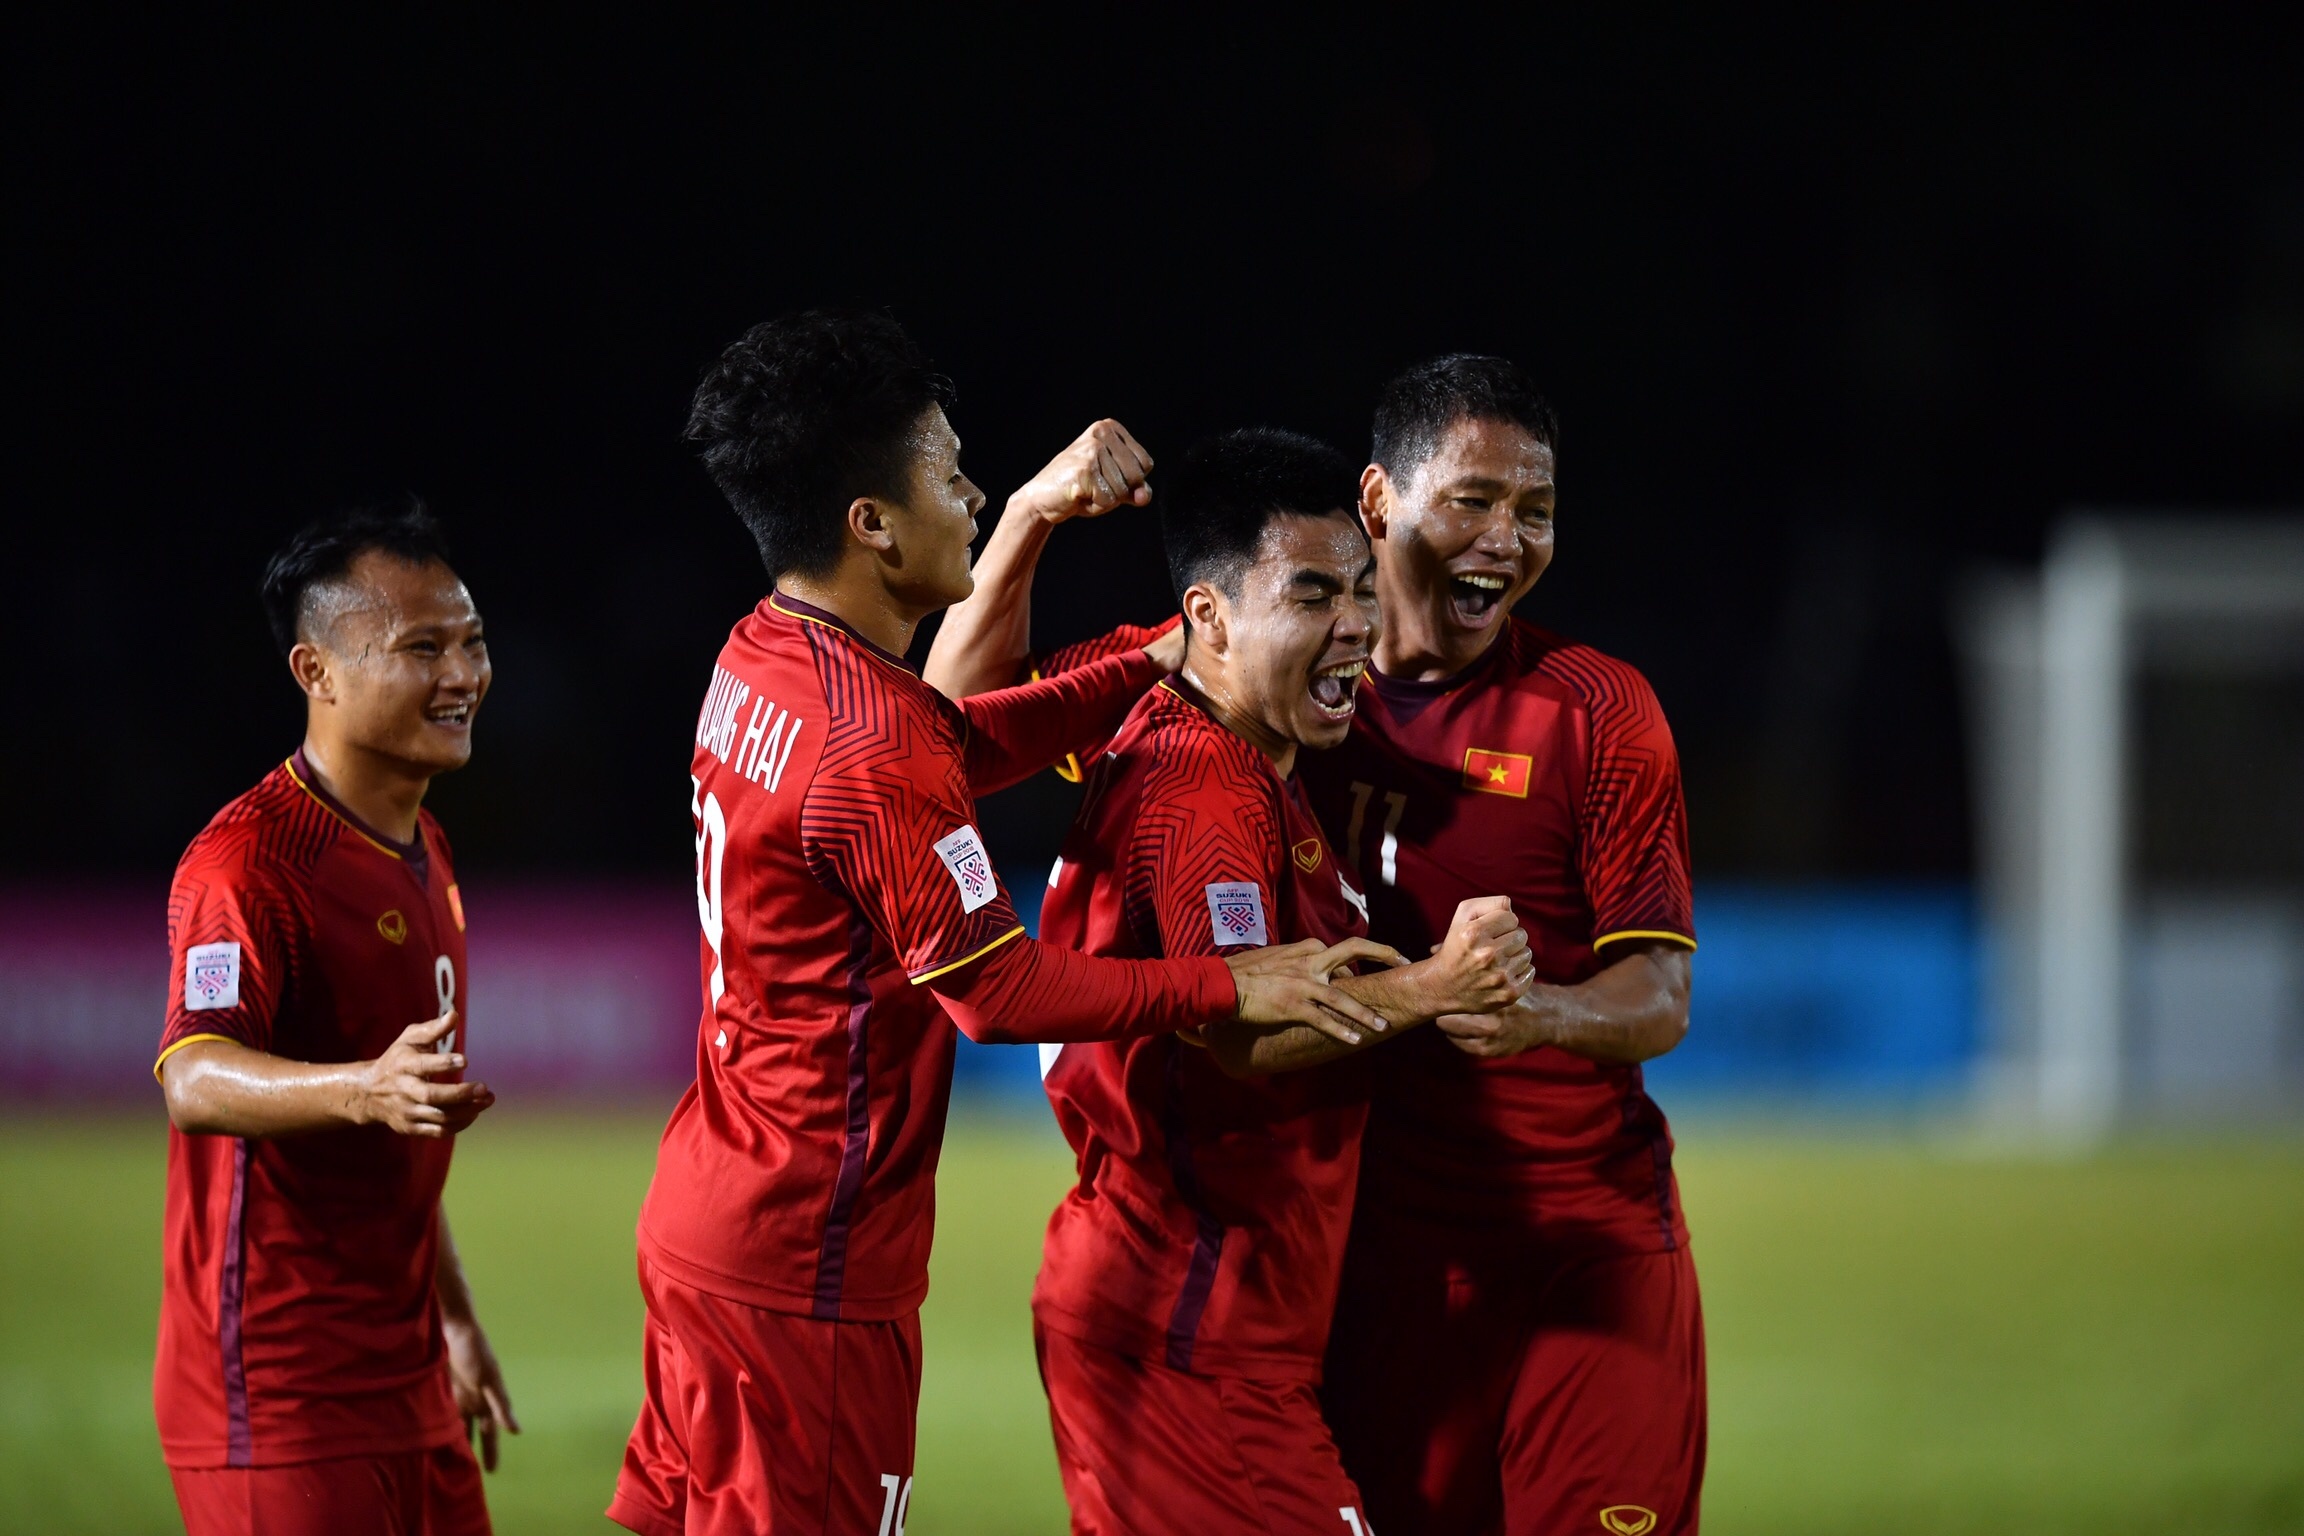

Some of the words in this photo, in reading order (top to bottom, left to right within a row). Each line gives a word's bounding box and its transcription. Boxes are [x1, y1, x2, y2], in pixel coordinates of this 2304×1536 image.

[735, 695, 803, 794] HAI
[947, 839, 974, 857] SUZUKI
[1349, 779, 1408, 887] 11
